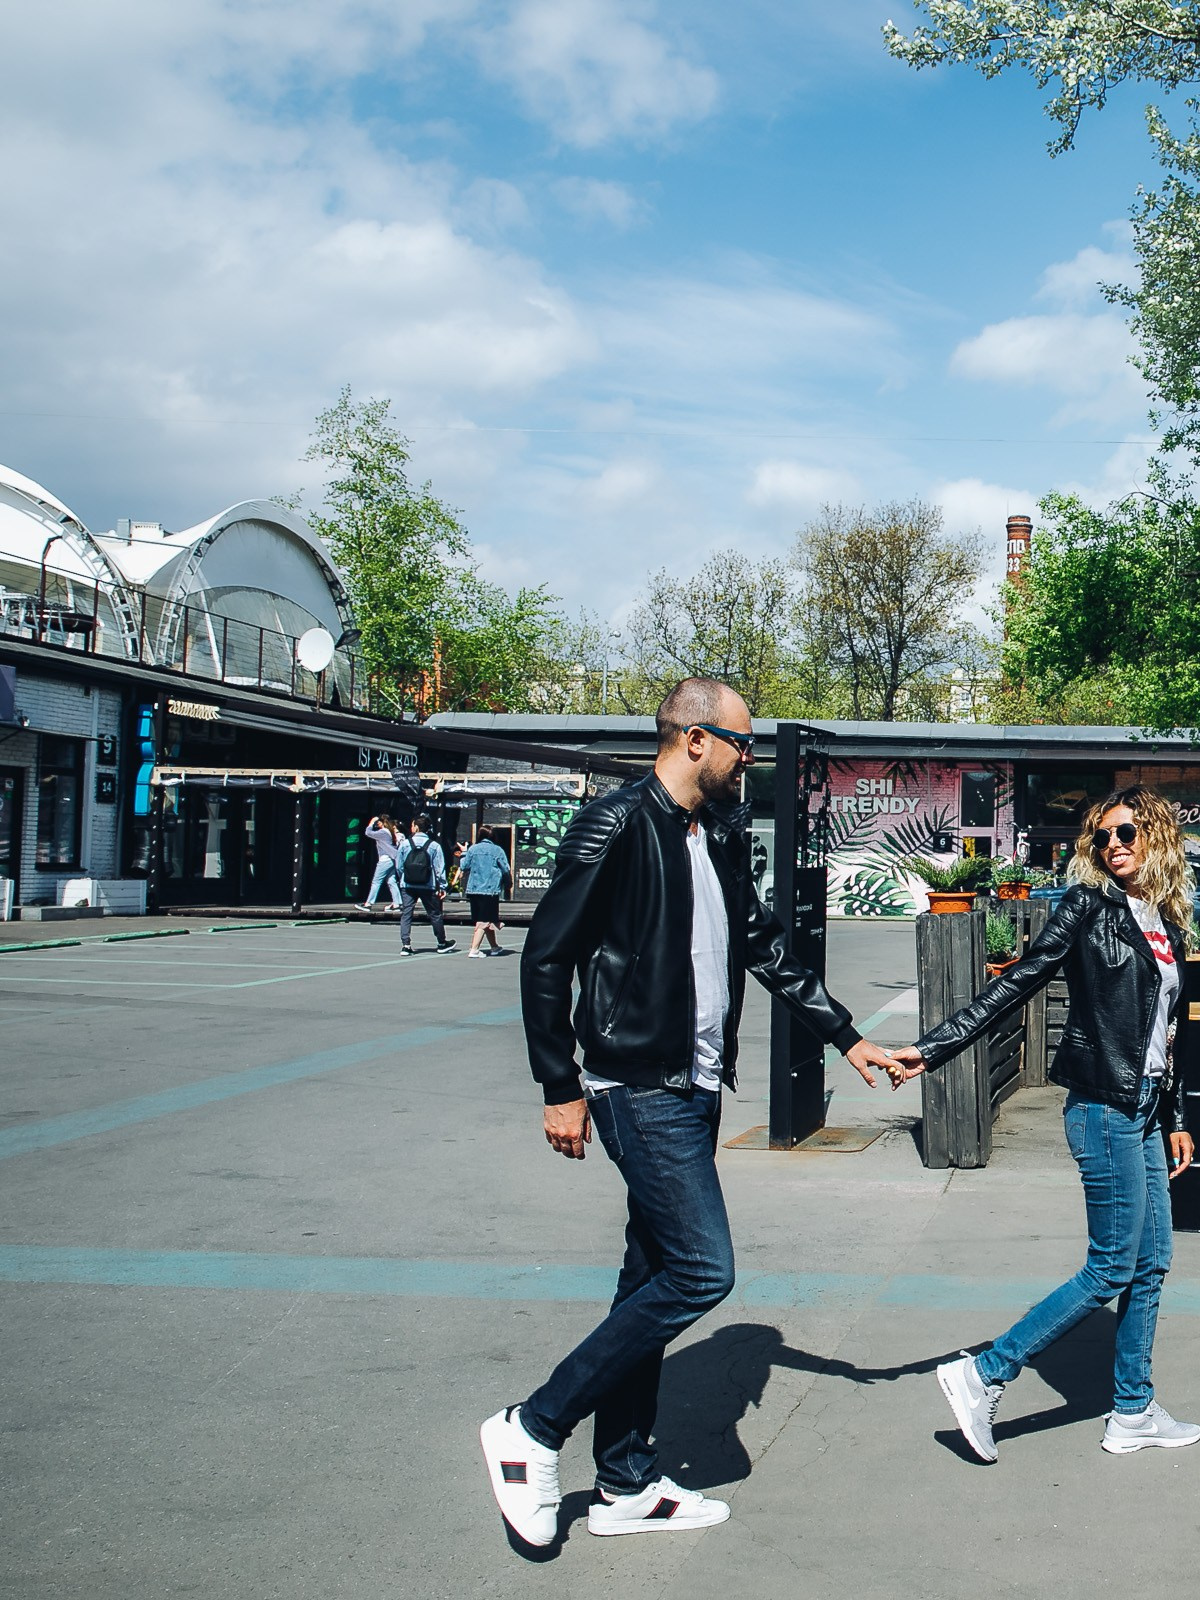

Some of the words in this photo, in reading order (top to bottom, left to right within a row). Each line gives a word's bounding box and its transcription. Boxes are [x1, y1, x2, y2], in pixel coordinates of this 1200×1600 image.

[103, 734, 112, 754] 9
[102, 782, 111, 792] 14
[855, 778, 893, 796] SHI
[830, 796, 920, 814] TRENDY
[523, 829, 531, 837] 4
[939, 838, 946, 846] 6
[519, 868, 550, 878] ROYAL
